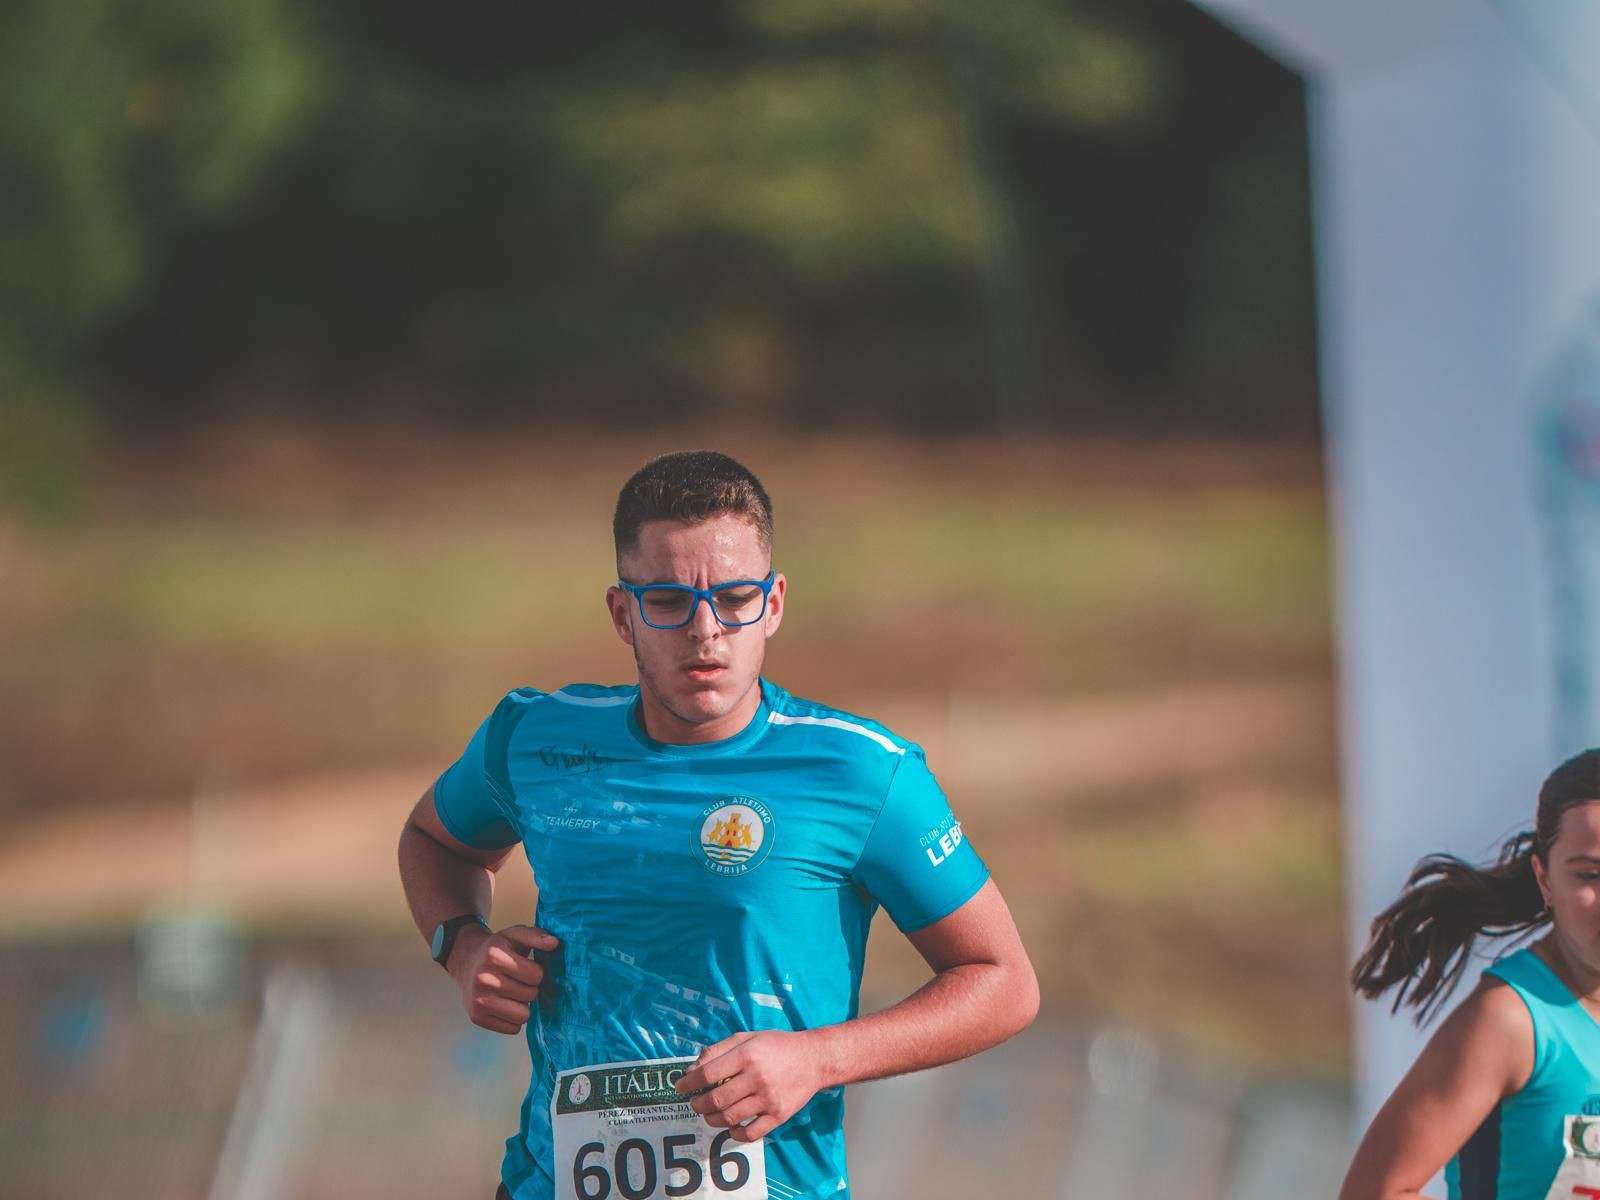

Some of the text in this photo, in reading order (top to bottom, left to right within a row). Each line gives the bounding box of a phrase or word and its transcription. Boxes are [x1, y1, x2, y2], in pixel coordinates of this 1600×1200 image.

[703, 797, 771, 824] CLUB ATLETISMO
[546, 816, 600, 829] TEAMERGY
[919, 828, 940, 847] CLUB
[704, 859, 747, 873] LEBRIJA
[603, 1068, 683, 1096] ITÁLIC
